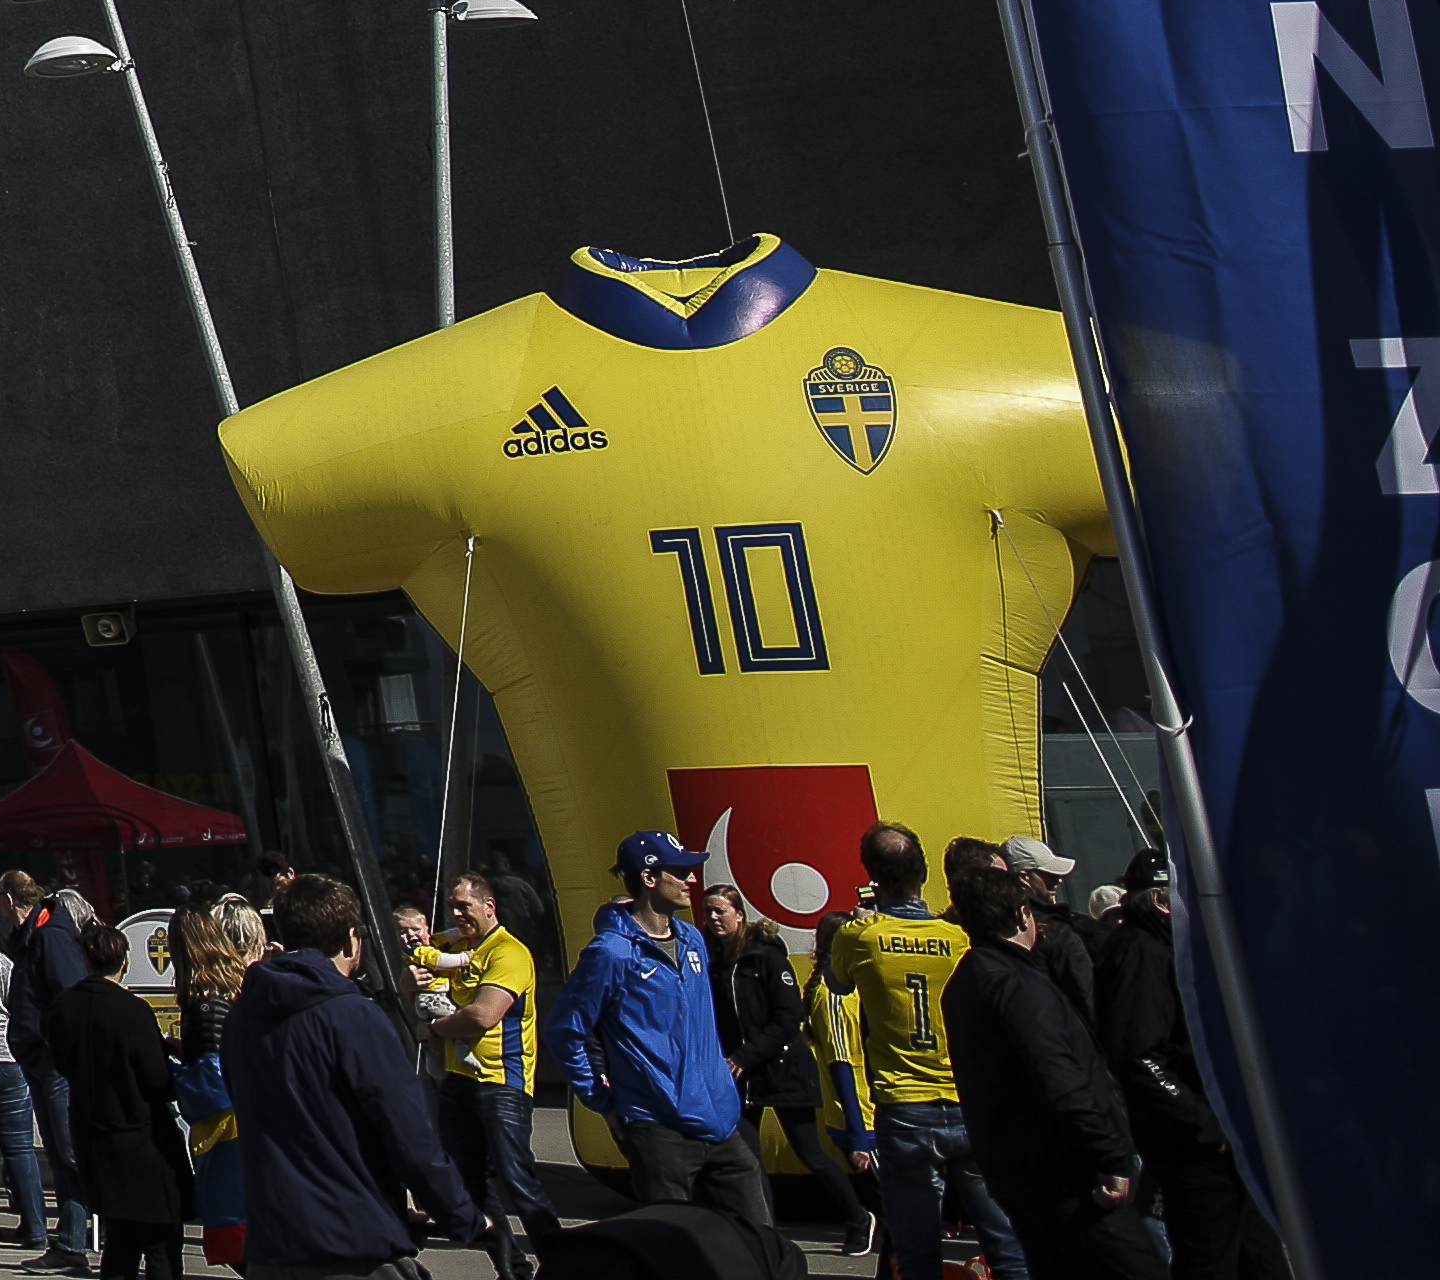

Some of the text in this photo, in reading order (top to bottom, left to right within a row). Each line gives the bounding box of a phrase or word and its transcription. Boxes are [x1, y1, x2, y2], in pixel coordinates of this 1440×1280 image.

[818, 382, 880, 394] SVERIGE
[503, 427, 609, 458] adidas
[648, 520, 832, 677] 10
[905, 972, 938, 1050] 1
